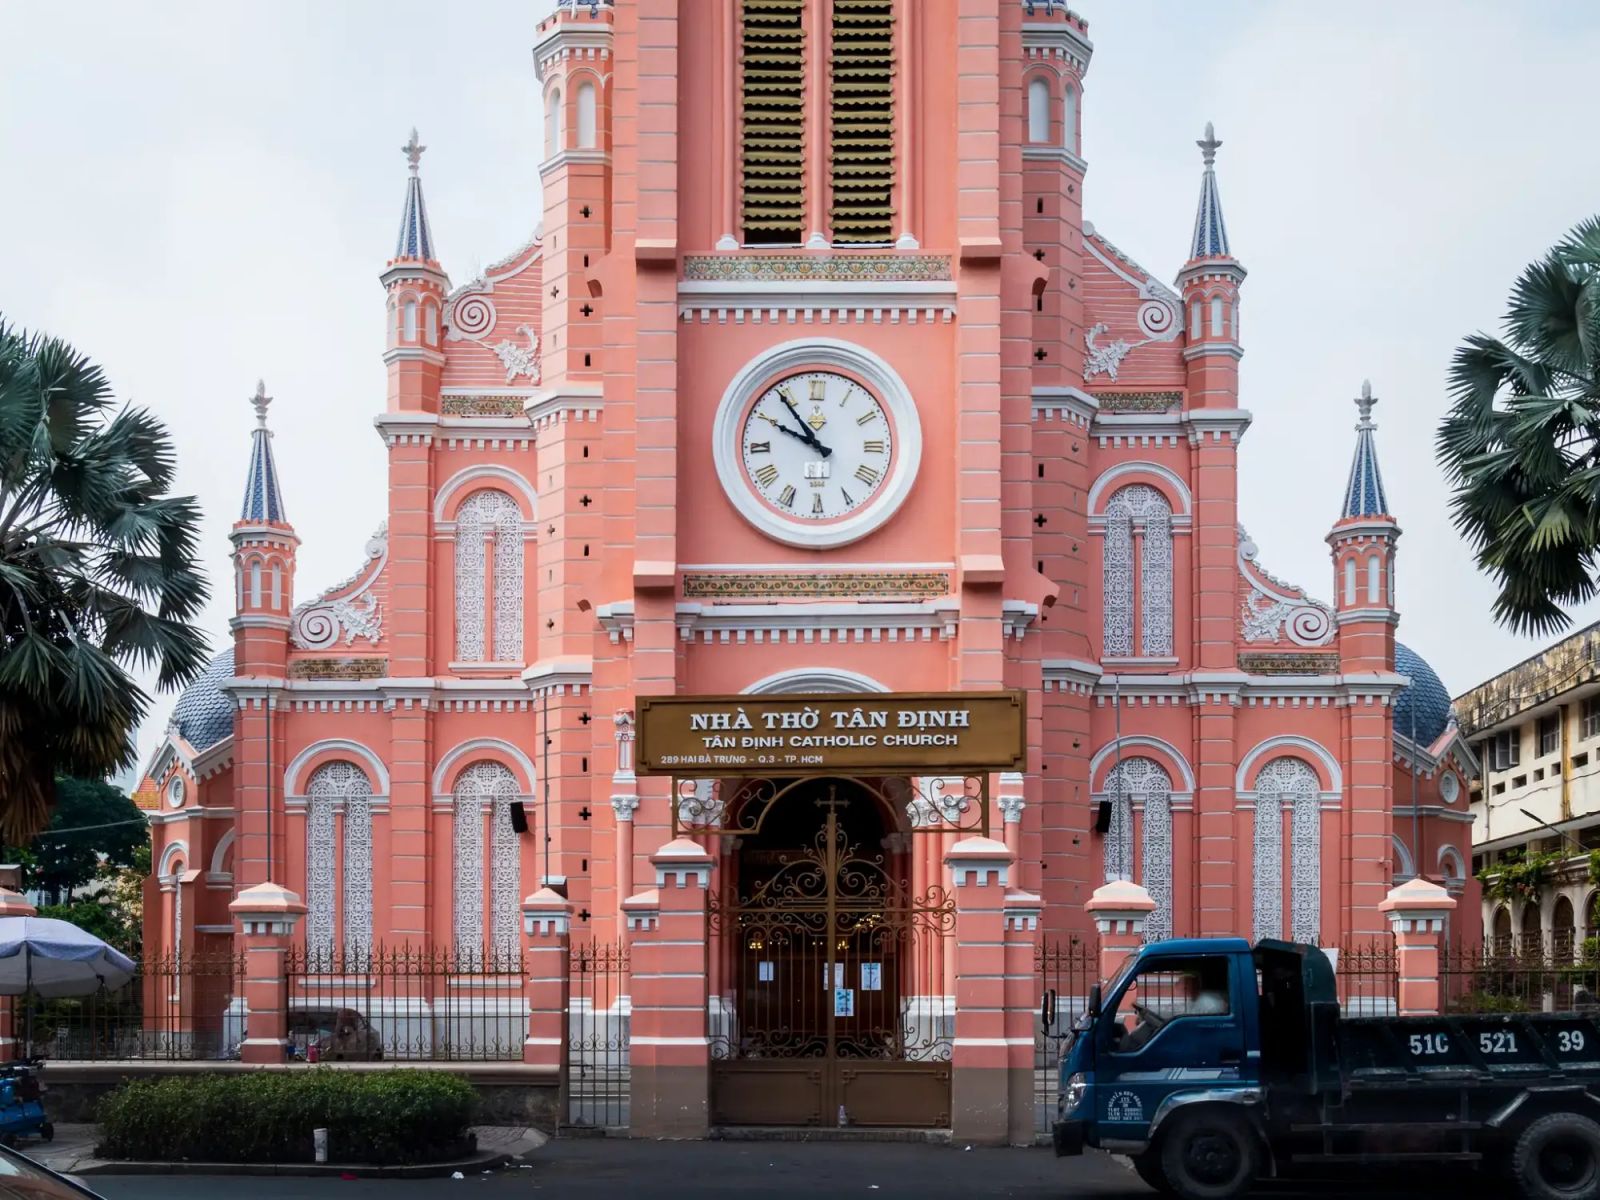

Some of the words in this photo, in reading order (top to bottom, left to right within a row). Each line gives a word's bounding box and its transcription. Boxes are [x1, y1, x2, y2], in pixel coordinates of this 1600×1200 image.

[751, 441, 770, 454] IX
[863, 440, 884, 454] III
[840, 486, 854, 506] V
[690, 707, 753, 730] NHÀ
[761, 706, 820, 729] THỜ
[830, 707, 889, 728] TÂN
[897, 710, 970, 731] ĐỊNH
[702, 735, 736, 748] TÂN
[741, 736, 784, 750] ĐỊNH
[789, 735, 877, 747] CATHOLIC
[883, 734, 958, 746] CHURCH
[661, 755, 679, 764] 289
[681, 755, 697, 763] HAI
[698, 753, 712, 763] BÀ
[713, 754, 747, 763] TRƯNG
[758, 755, 775, 763] Q.3
[784, 755, 800, 763] TP.
[801, 755, 824, 763] HCM
[1409, 1033, 1449, 1055] 51C
[1479, 1032, 1518, 1053] 521
[1558, 1030, 1585, 1052] 39
